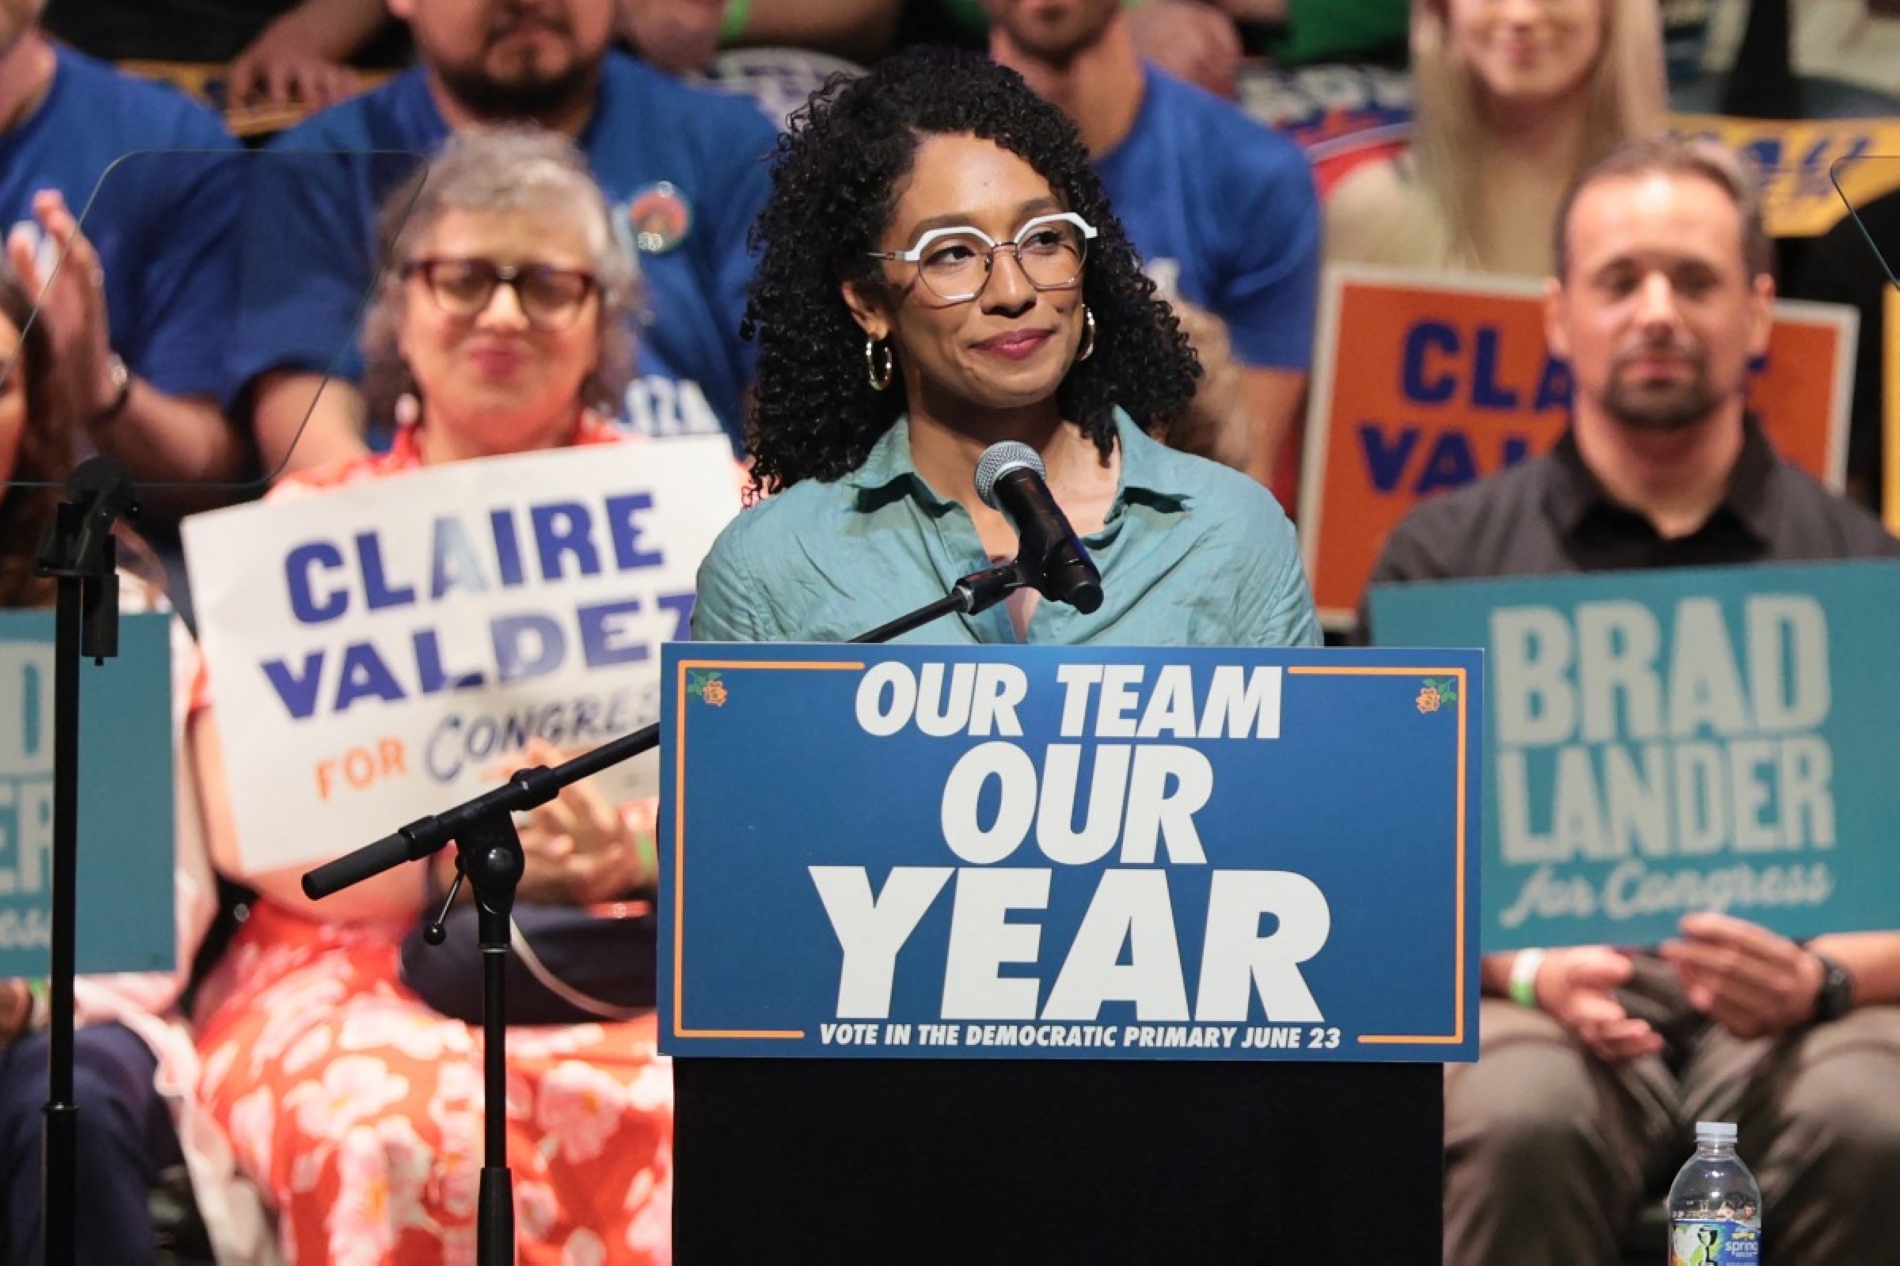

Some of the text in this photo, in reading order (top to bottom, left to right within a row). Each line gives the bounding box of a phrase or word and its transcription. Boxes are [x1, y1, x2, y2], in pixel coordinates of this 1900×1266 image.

[285, 492, 664, 624] CLAIRE
[855, 661, 1282, 739] OUR TEAM
[1491, 593, 1832, 746] BRAD
[315, 677, 660, 803] FOR CONGRES
[940, 740, 1214, 865] OUR
[1496, 732, 1837, 866] LANDER
[807, 865, 1331, 1023] YEAR
[1500, 856, 1834, 928] for Congress
[820, 1023, 1341, 1049] VOTE IN THE DEMOCRATIC PRIMARY JUNE 23
